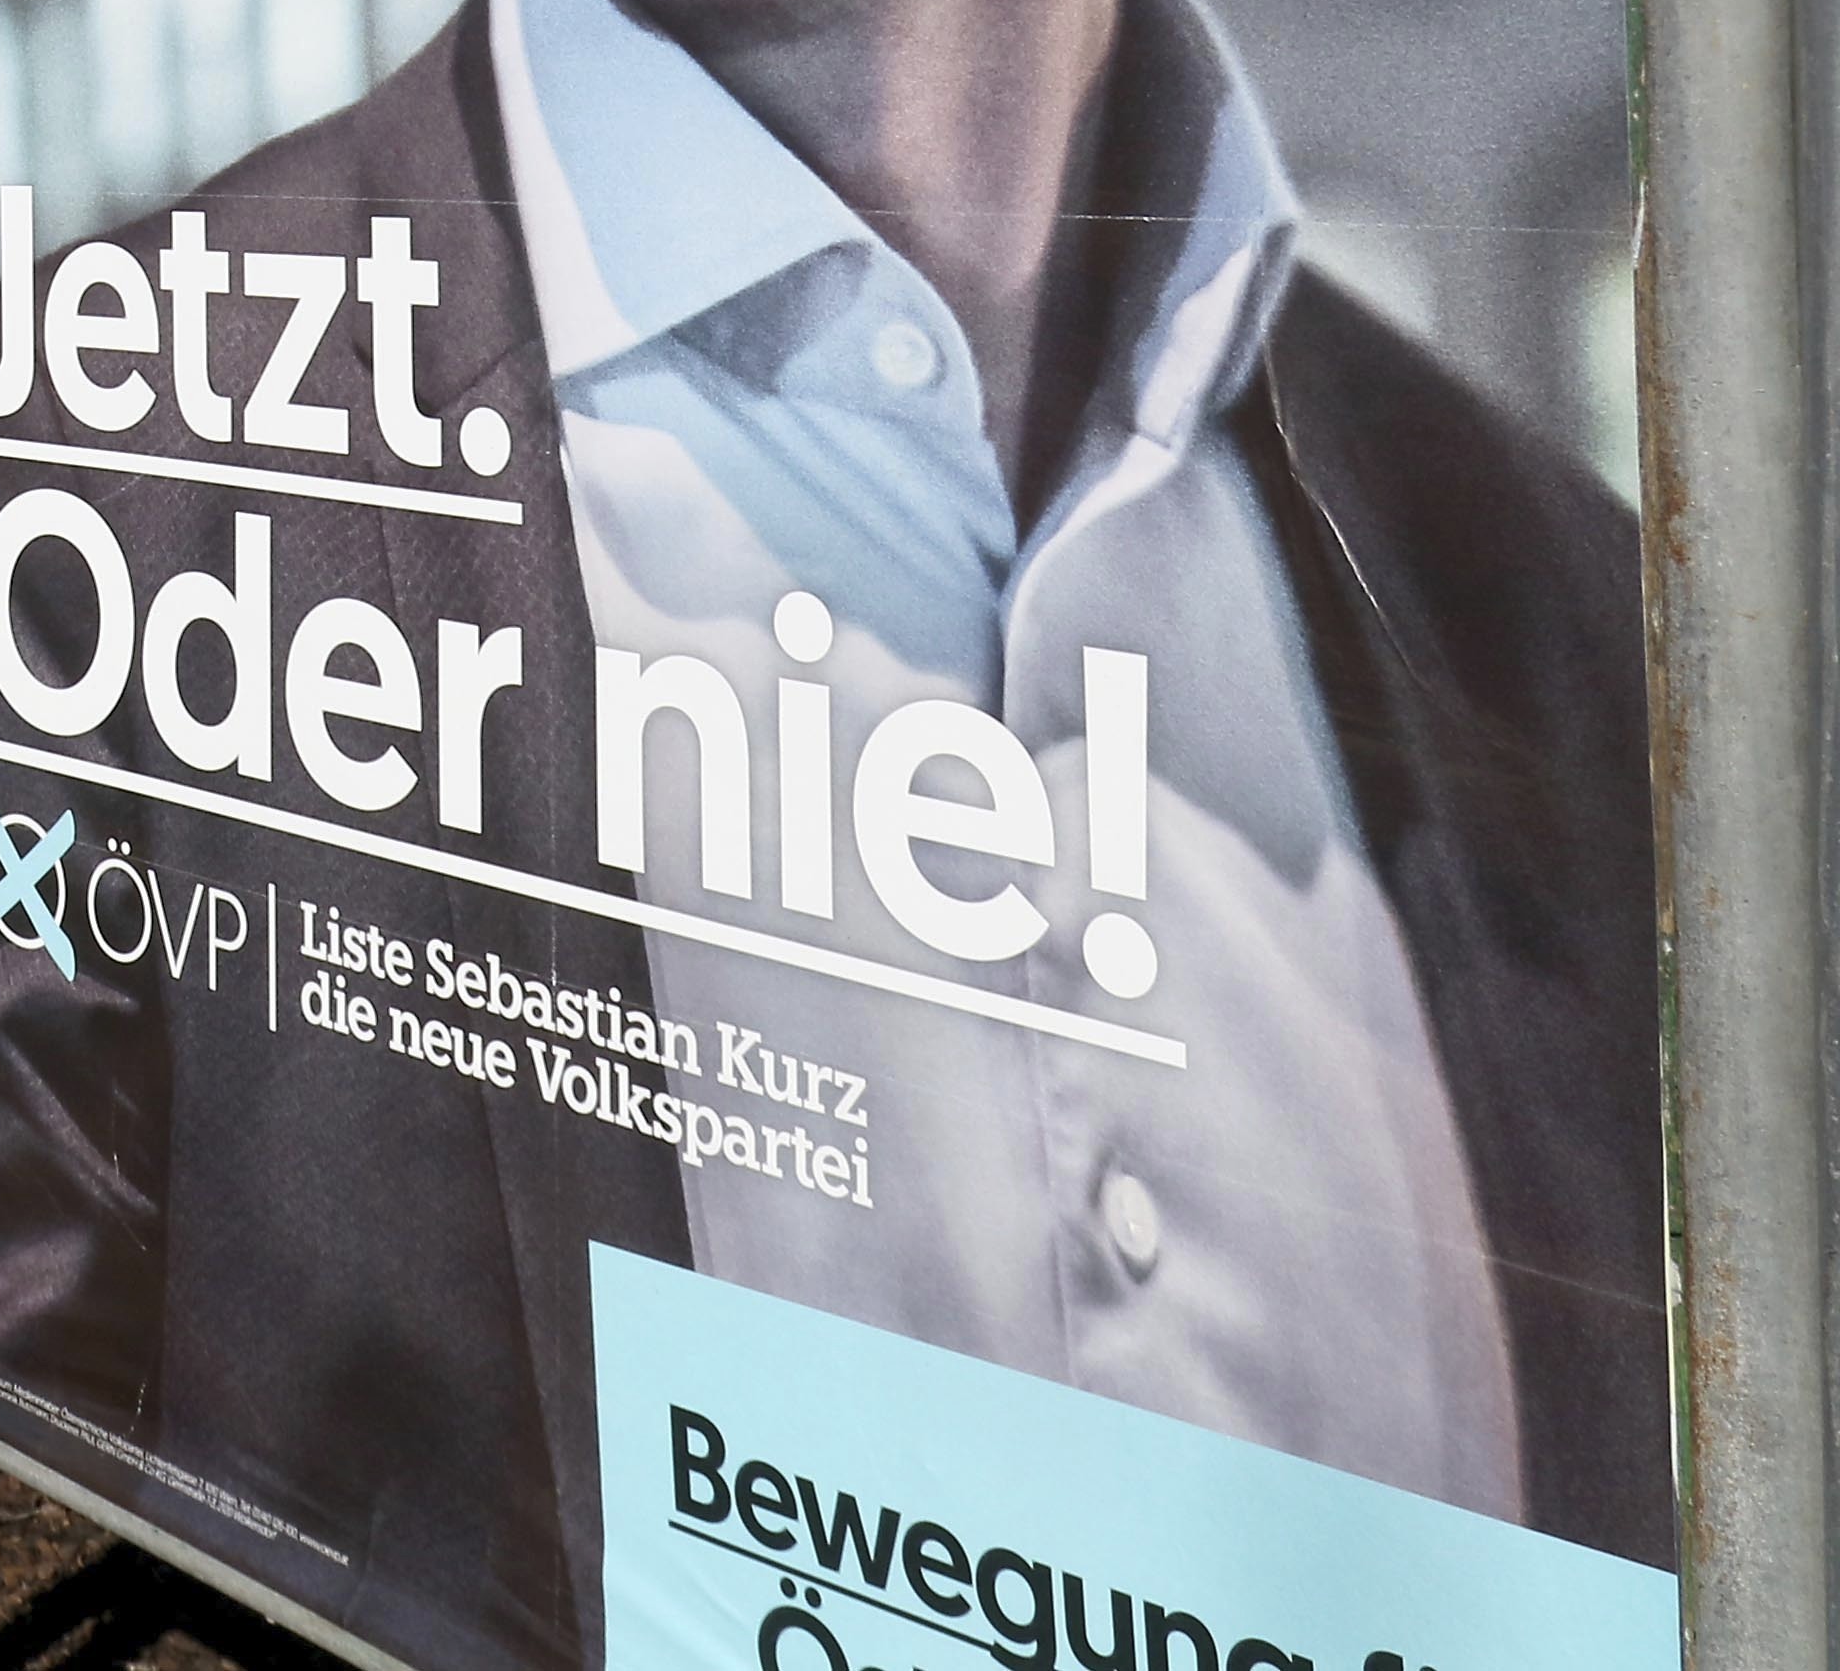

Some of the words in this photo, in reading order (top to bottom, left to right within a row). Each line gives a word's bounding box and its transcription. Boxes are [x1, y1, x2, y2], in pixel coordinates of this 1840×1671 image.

[86, 837, 248, 992] ÖVP
[595, 589, 1160, 1000] nie!
[298, 900, 414, 987] Liste
[425, 936, 700, 1078] Sebastian
[716, 1020, 870, 1127] Kurz
[300, 969, 378, 1043] die
[388, 1003, 517, 1089] neue
[527, 1035, 875, 1211] Volkspartei
[669, 1404, 1315, 1671] Bewegun
